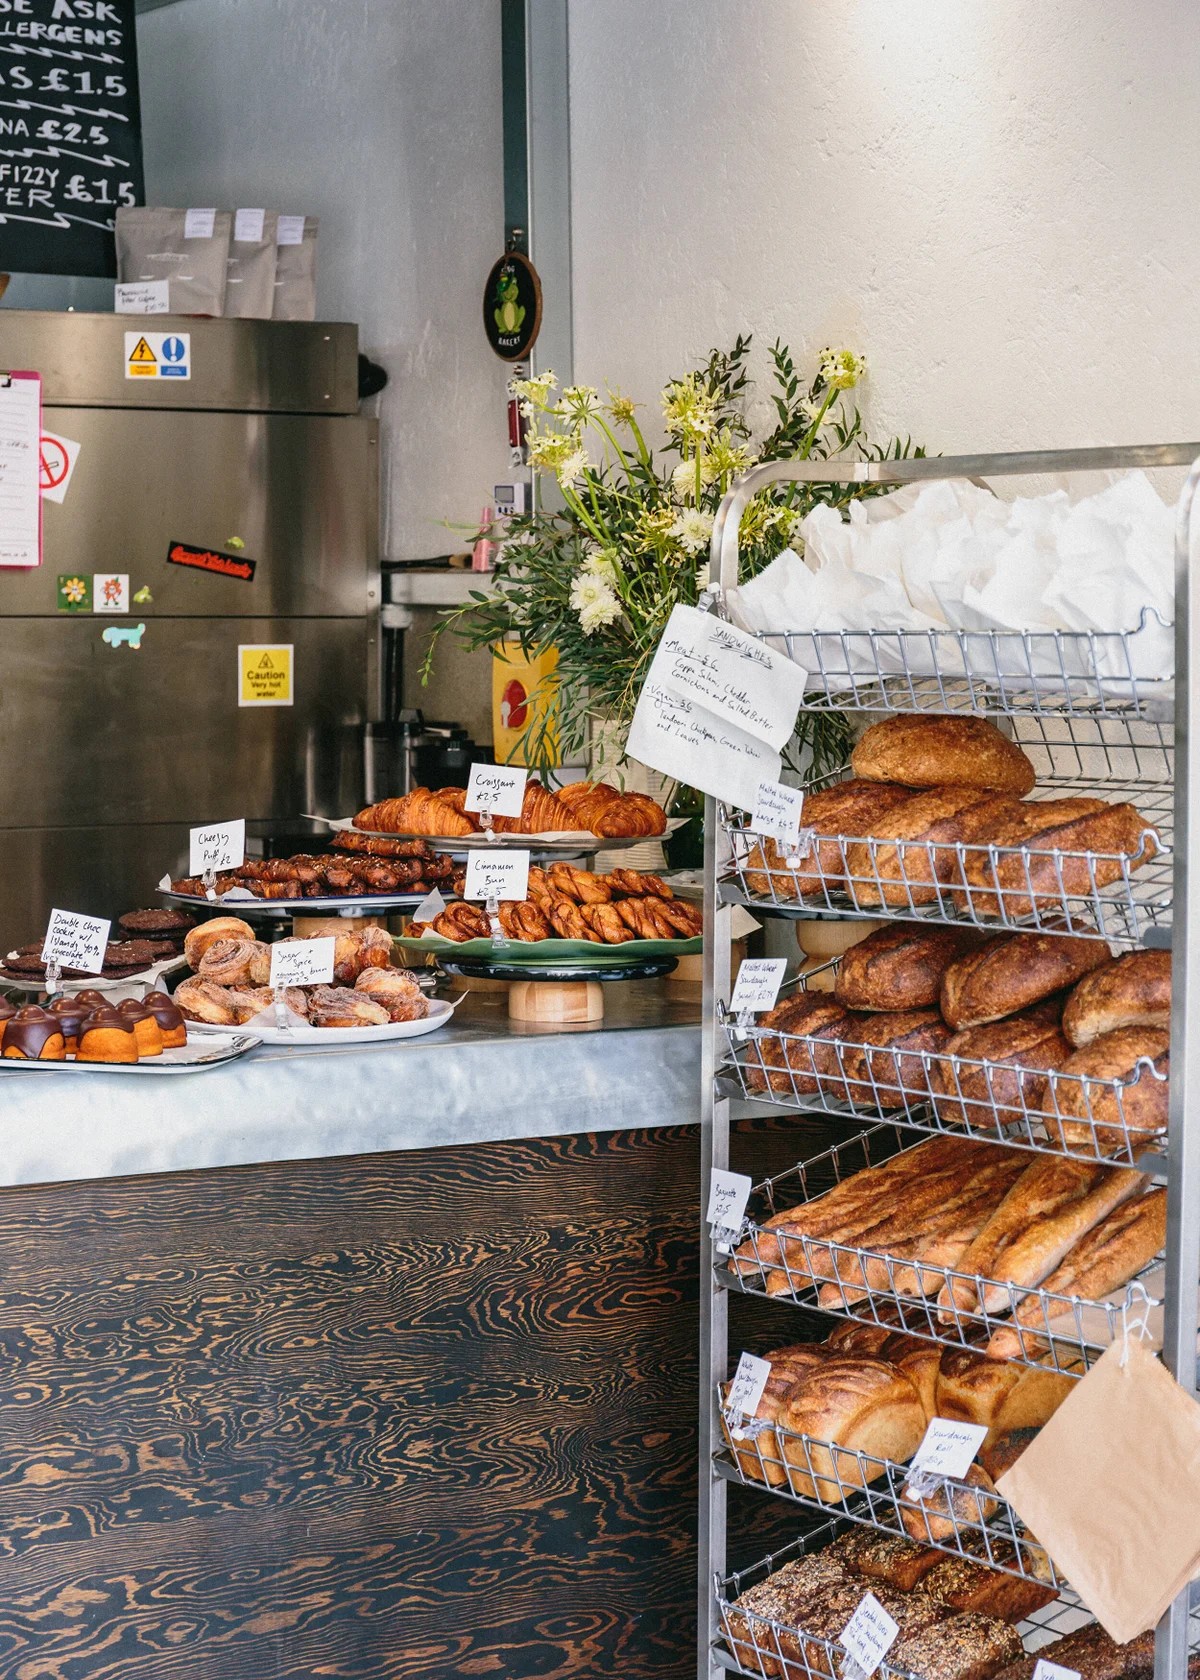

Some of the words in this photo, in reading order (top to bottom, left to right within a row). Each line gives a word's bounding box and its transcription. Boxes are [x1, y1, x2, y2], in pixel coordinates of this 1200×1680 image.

[51, 0, 122, 24] ASK
[0, 21, 123, 46] LERGENS
[0, 66, 33, 89] S
[38, 67, 127, 97] £1.5
[35, 119, 109, 146] £2.5
[0, 164, 60, 189] FIZZY
[63, 175, 136, 207] £1.5
[0, 187, 55, 208] ER
[247, 670, 286, 680] Caution
[475, 774, 516, 791] Croissant
[198, 833, 230, 847] Cheesy
[474, 859, 514, 871] Cinnamon
[484, 875, 505, 886] Bun
[53, 913, 80, 928] Double
[278, 950, 302, 964] Sugar
